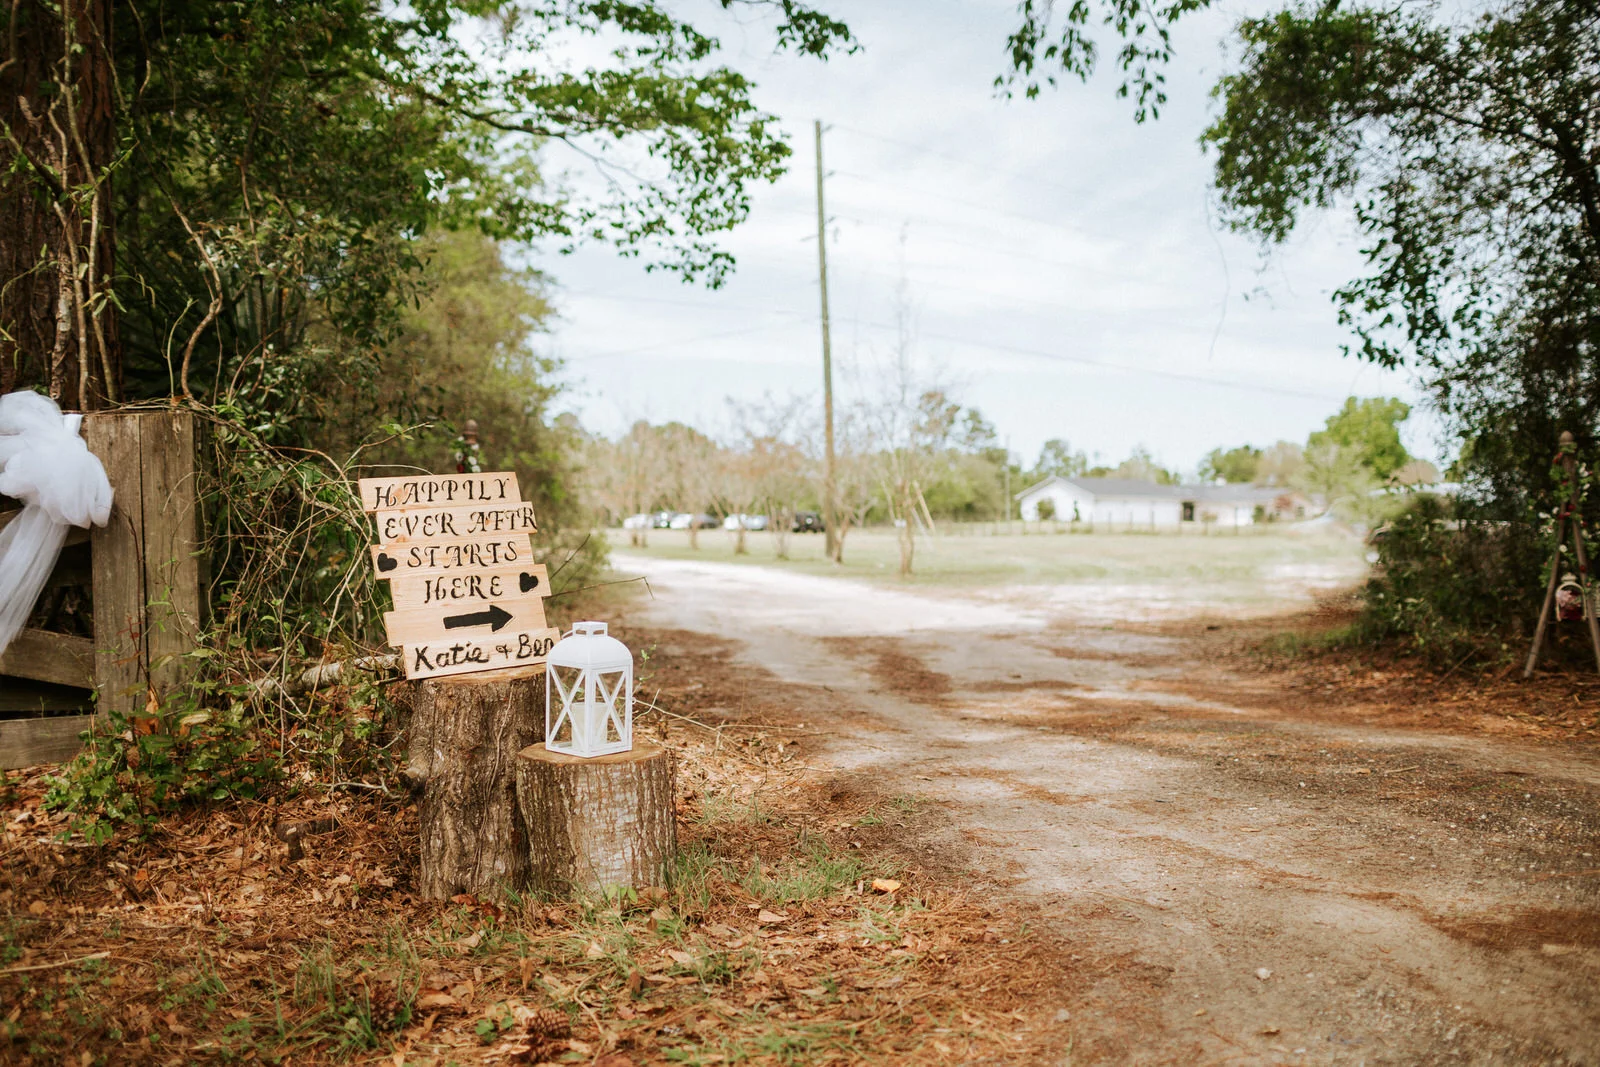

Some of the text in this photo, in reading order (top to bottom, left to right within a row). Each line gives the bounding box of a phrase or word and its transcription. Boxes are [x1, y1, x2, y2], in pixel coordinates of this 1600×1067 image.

[373, 478, 510, 509] HAPPILY
[385, 506, 538, 539] EVER AFTR
[407, 540, 518, 569] STARTS
[424, 575, 503, 604] HERE
[414, 641, 489, 672] Katie
